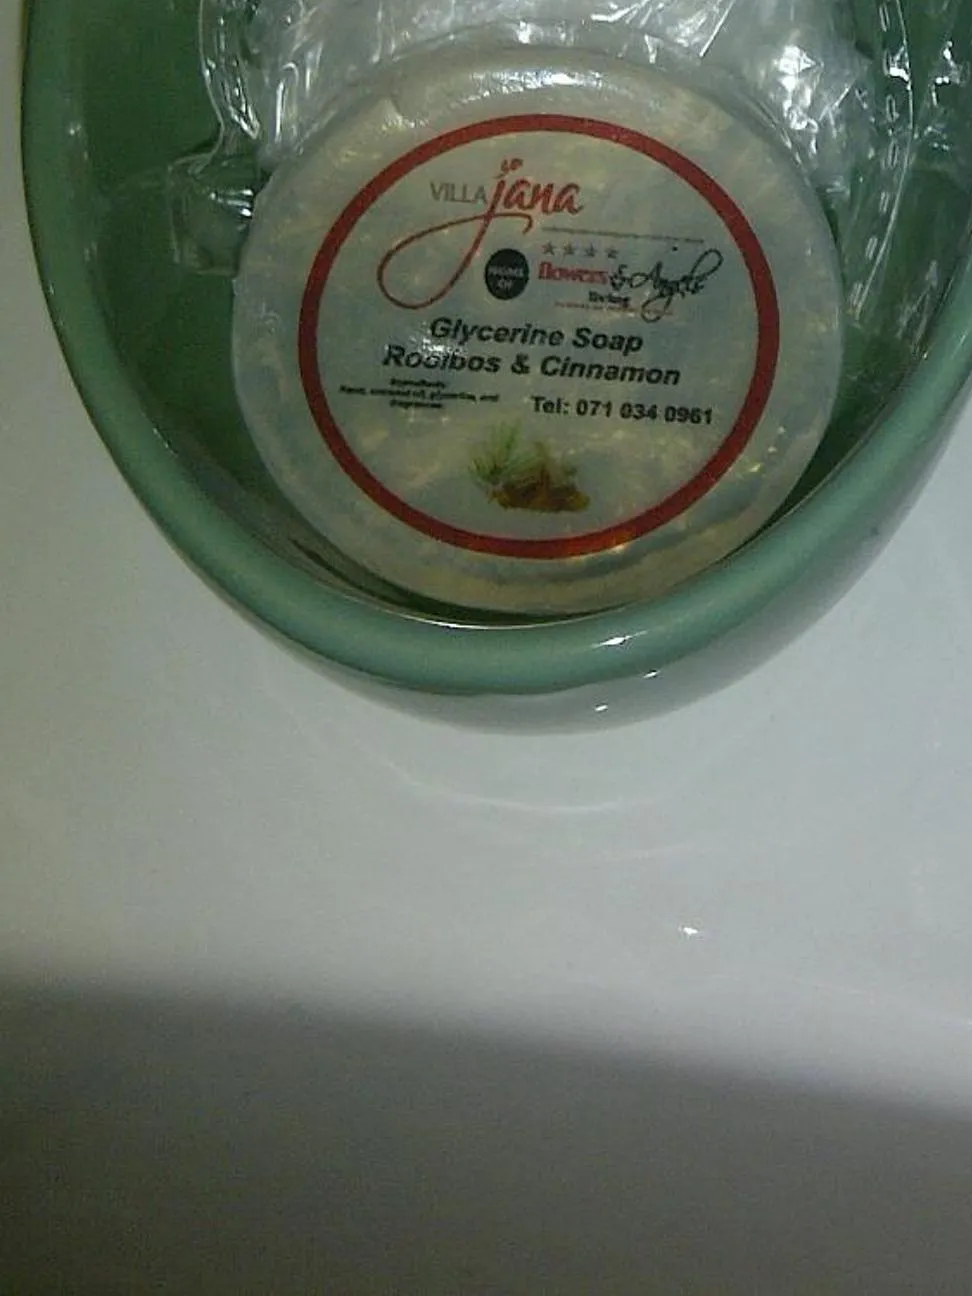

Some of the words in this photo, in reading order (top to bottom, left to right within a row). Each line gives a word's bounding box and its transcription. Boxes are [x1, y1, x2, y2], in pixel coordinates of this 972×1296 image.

[430, 181, 487, 205] VILLA
[376, 157, 584, 310] jana
[429, 315, 565, 347] Glycerine
[571, 326, 645, 355] Soap
[381, 342, 502, 375] Rooibos
[510, 354, 531, 376] &
[539, 354, 682, 387] Cinnamon
[530, 394, 570, 415] Tel:
[575, 397, 613, 419] 071
[619, 400, 658, 422] 034
[663, 403, 714, 426] 0961
